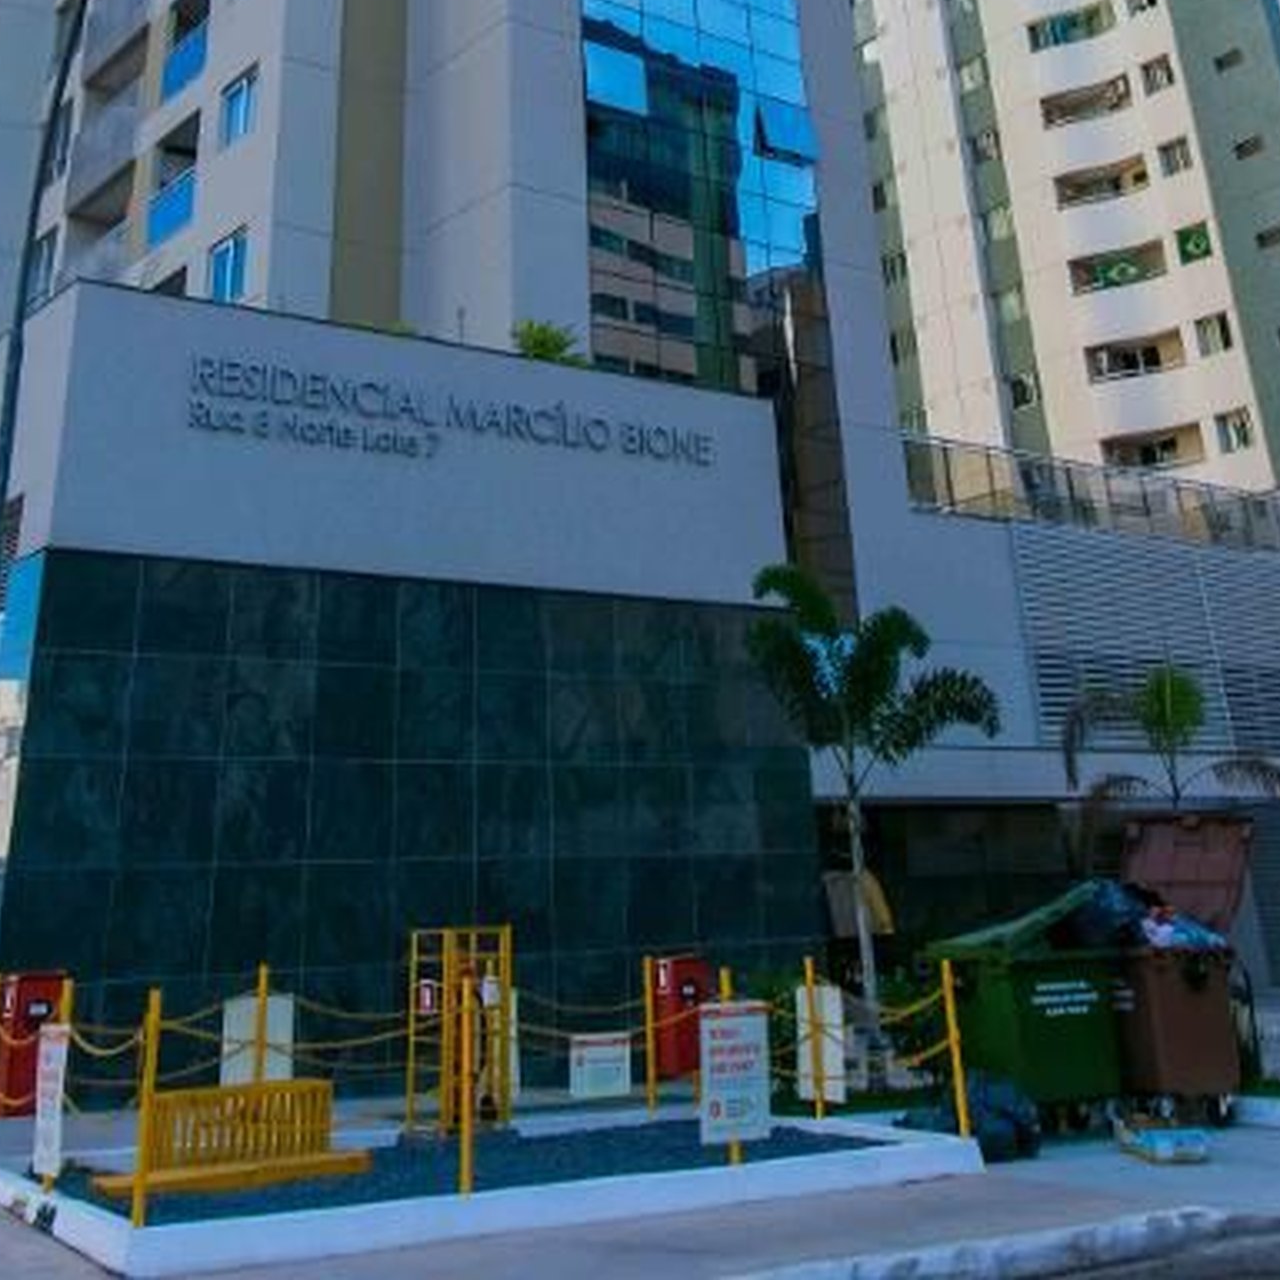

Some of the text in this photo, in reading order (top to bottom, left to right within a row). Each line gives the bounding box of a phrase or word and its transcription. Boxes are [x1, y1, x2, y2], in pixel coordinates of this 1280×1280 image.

[190, 354, 716, 467] RESIDENCIAL MARCÍLIO BIONE
